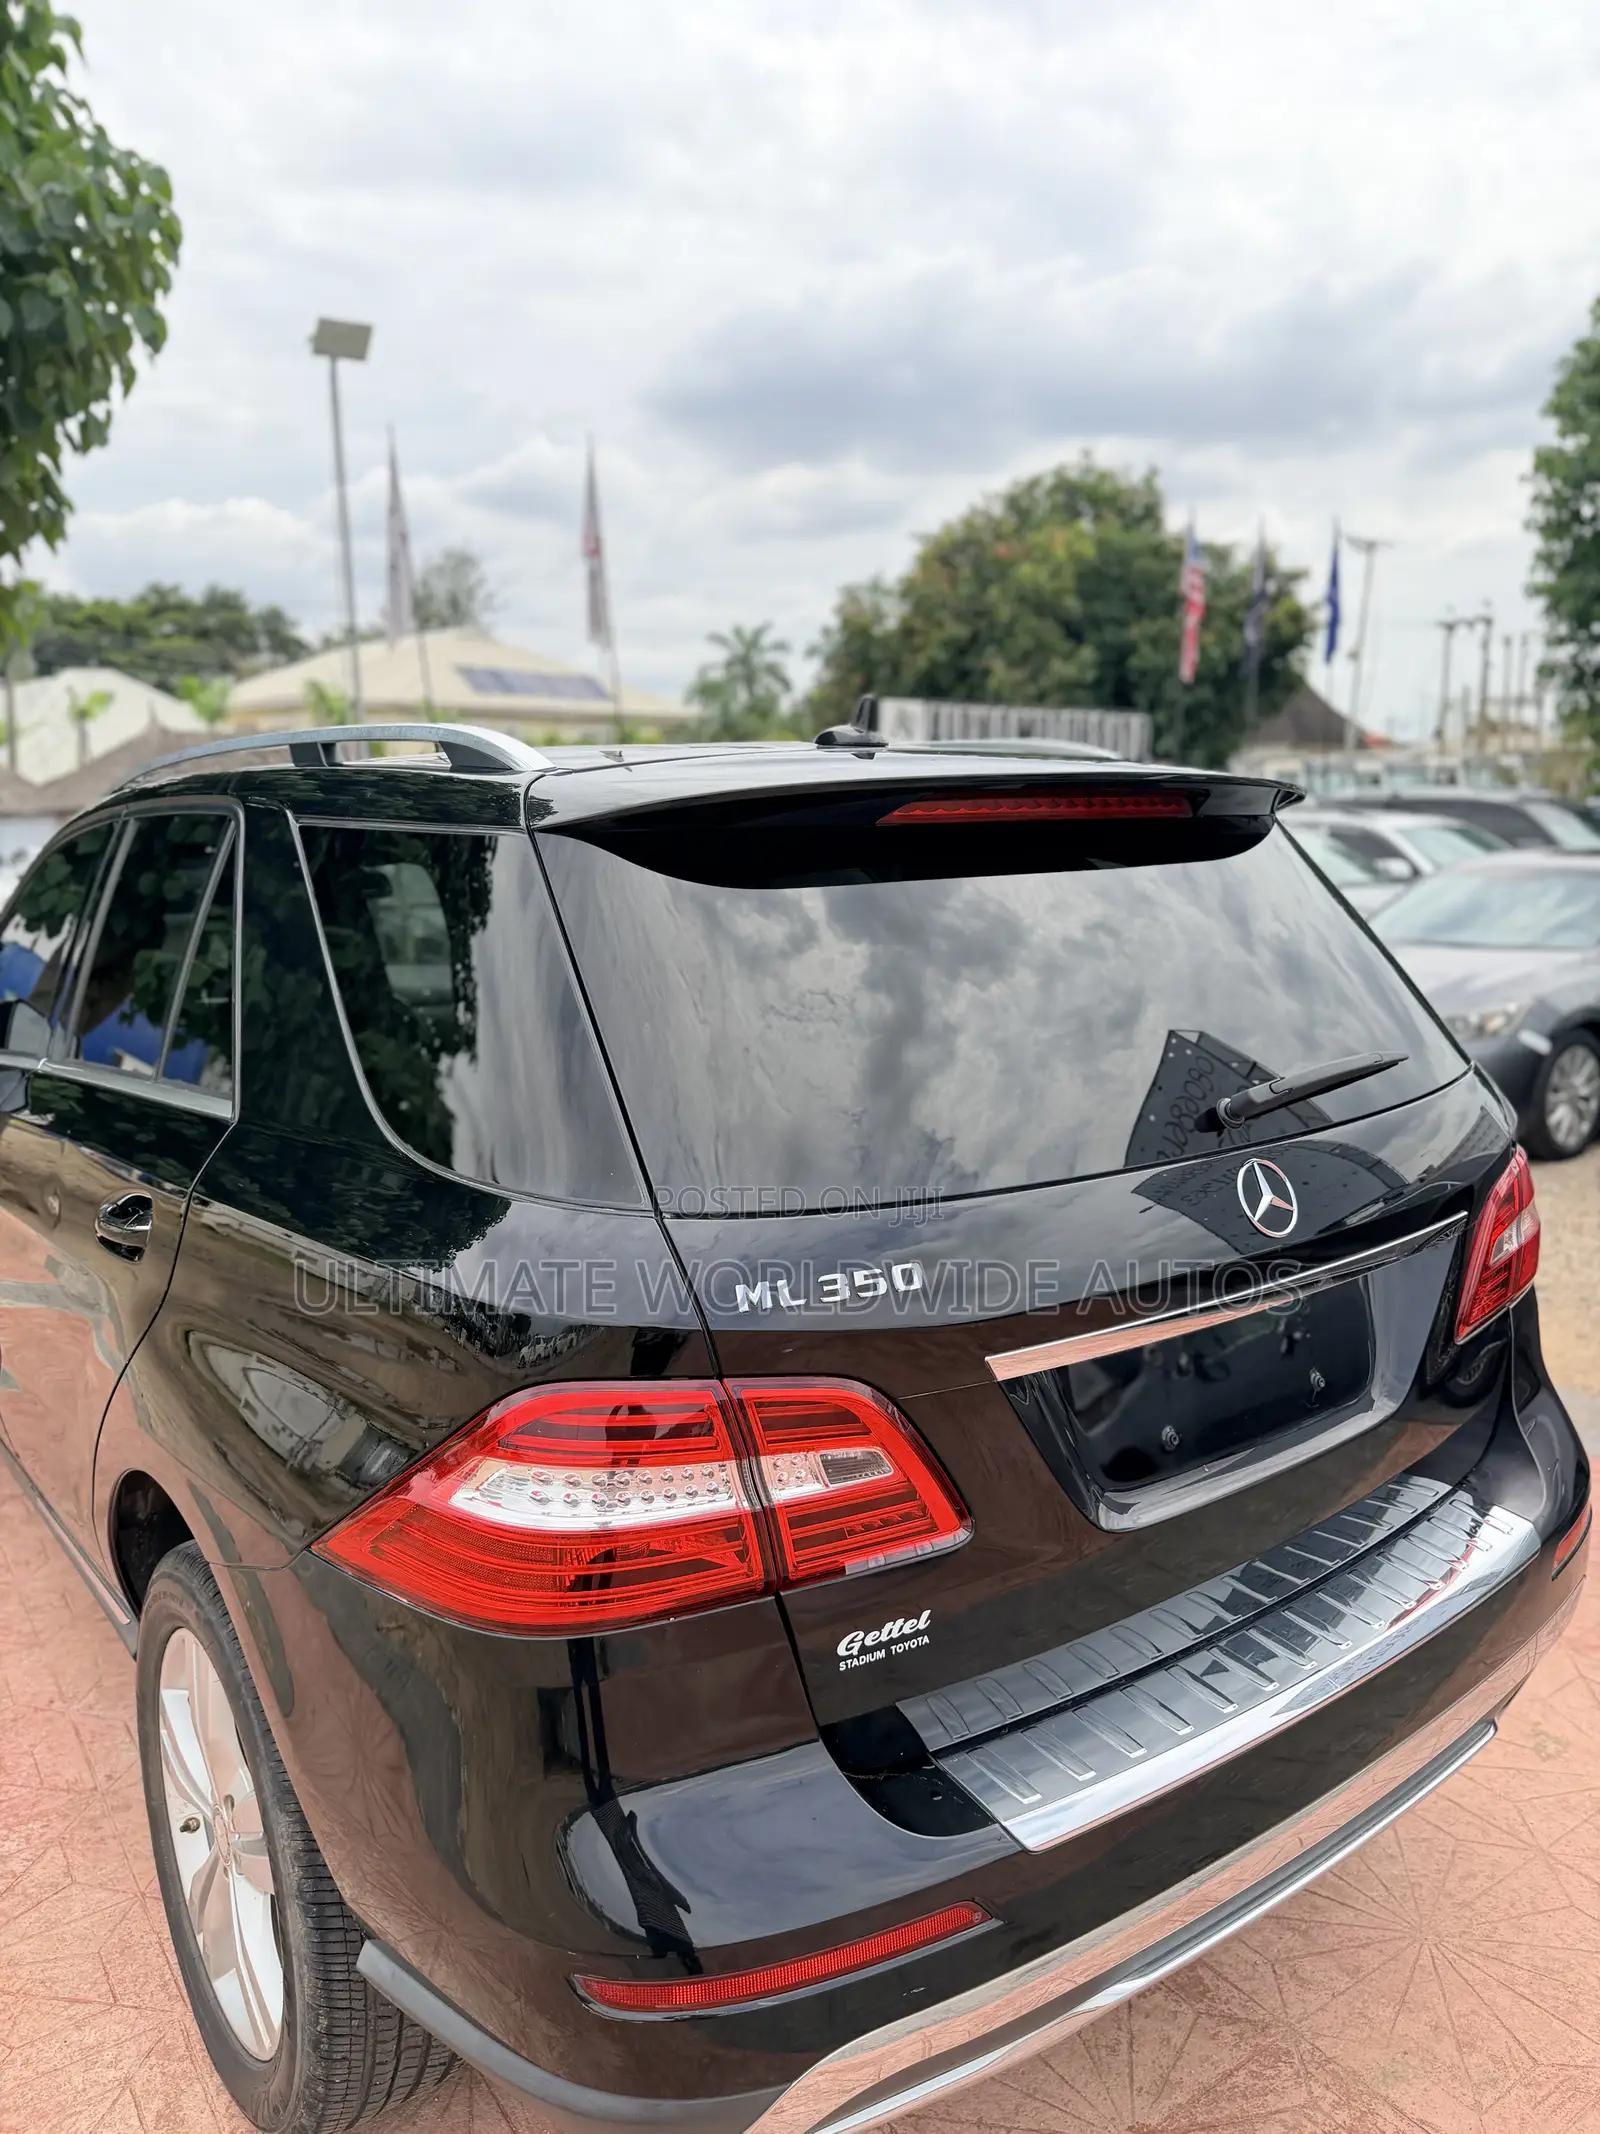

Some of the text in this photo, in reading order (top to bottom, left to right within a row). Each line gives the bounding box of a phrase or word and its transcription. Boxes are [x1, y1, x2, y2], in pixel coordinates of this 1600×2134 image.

[735, 1262, 922, 1313] ML 350
[837, 1609, 931, 1656] Gettel
[839, 1635, 930, 1671] STADIUM TOYOTA
